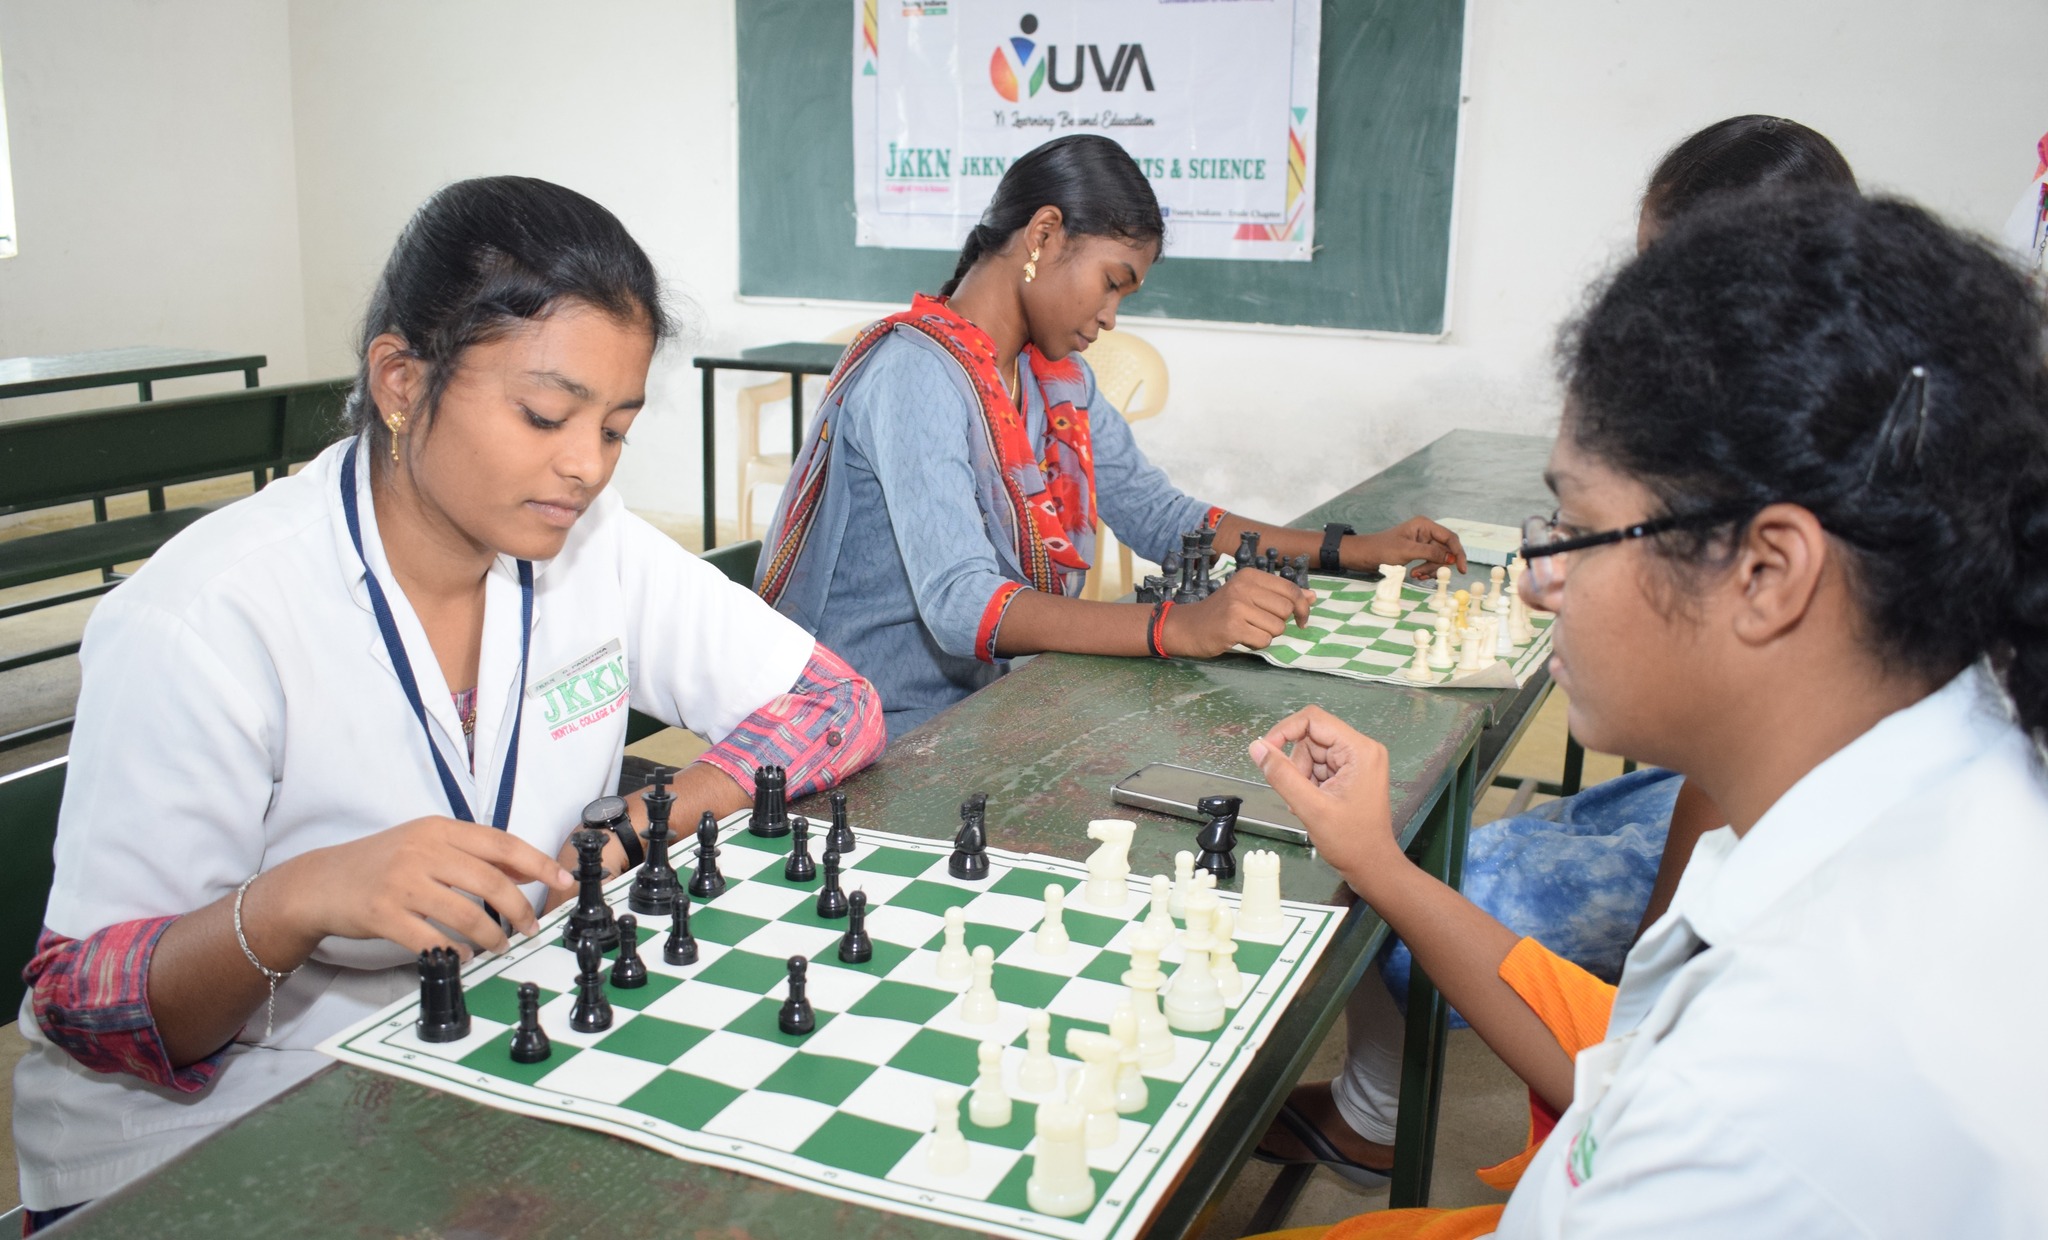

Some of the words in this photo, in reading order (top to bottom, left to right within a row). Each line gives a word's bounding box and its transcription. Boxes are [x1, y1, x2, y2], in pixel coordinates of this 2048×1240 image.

[1011, 110, 1055, 131] Learning
[1101, 109, 1156, 129] Education
[885, 142, 951, 178] JKKN
[960, 156, 1006, 177] JKKN
[1170, 158, 1182, 179] &
[1188, 157, 1266, 180] SCIENCE
[540, 655, 629, 723] JKKN
[550, 721, 579, 741] DENTAL
[579, 706, 609, 728] COLLEGE
